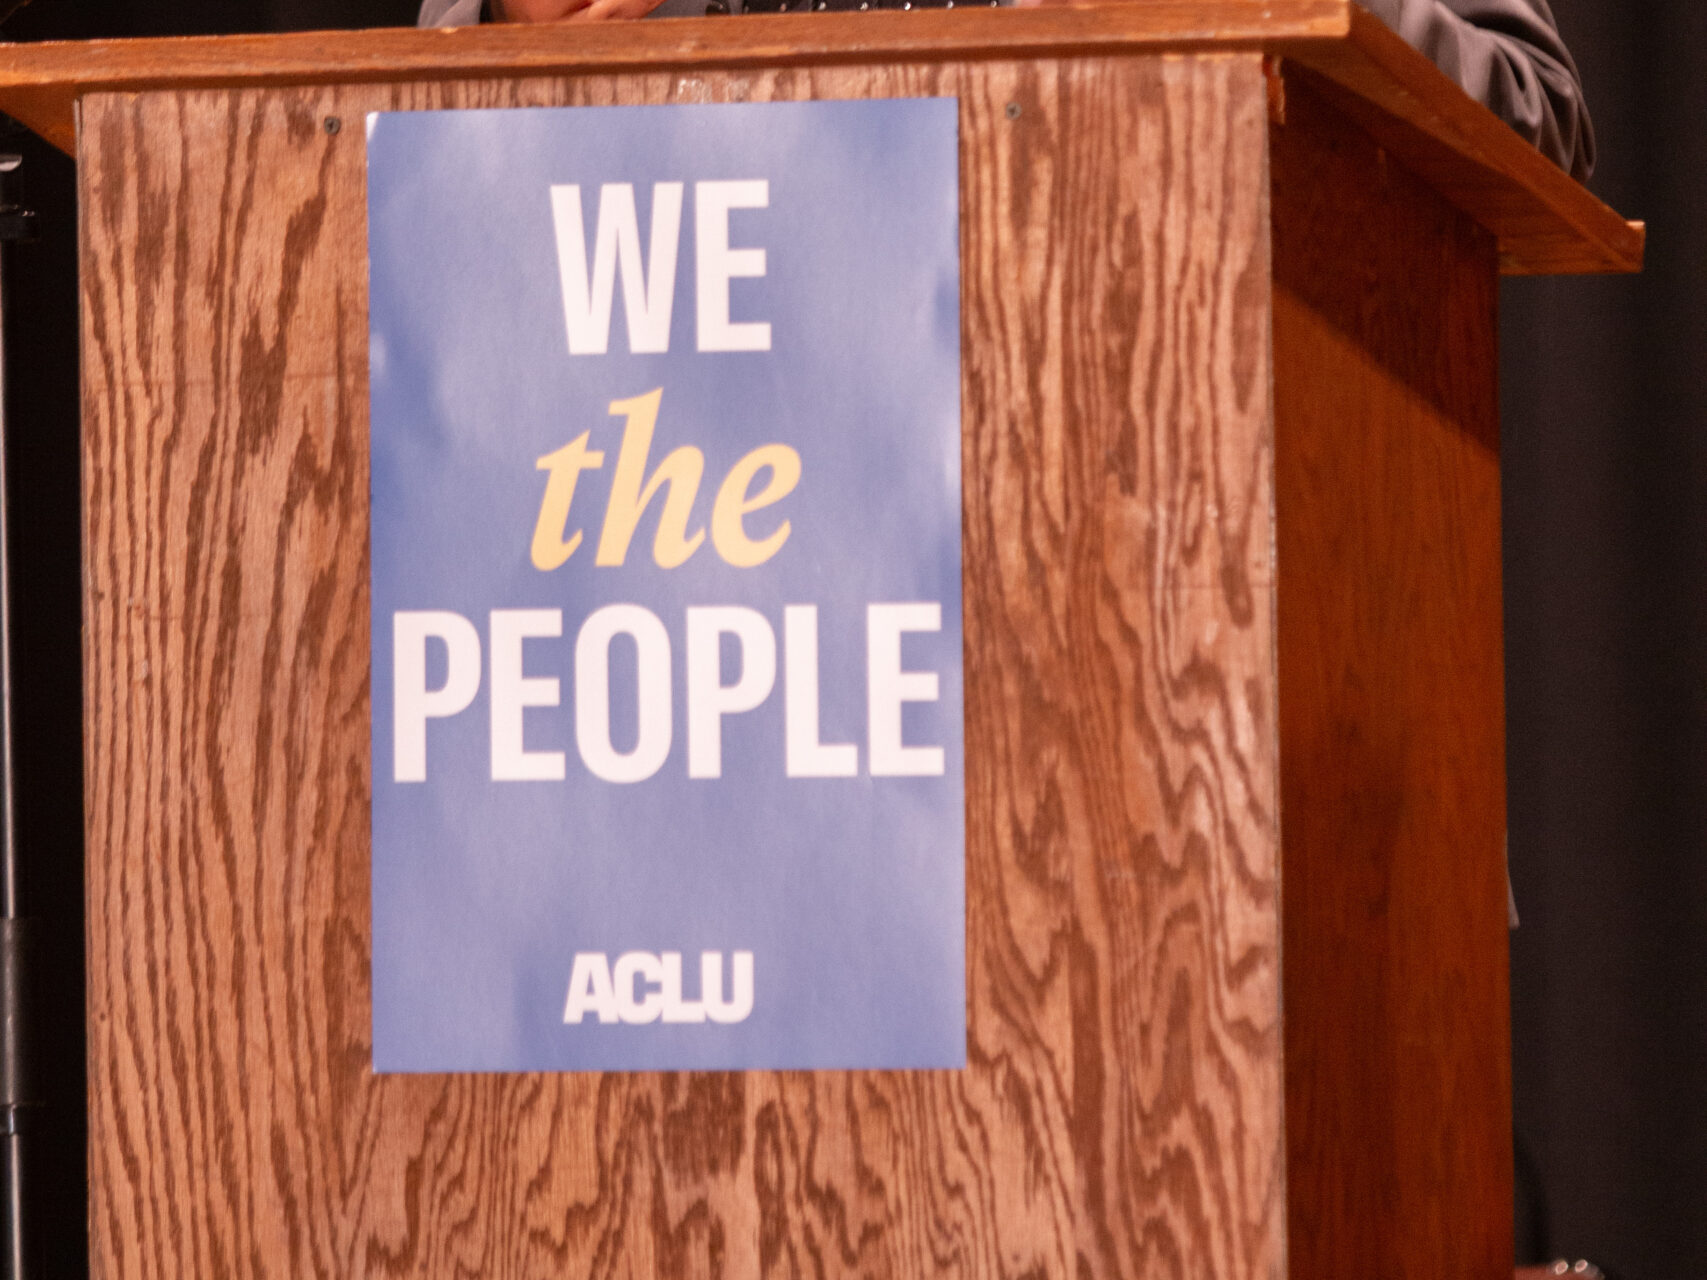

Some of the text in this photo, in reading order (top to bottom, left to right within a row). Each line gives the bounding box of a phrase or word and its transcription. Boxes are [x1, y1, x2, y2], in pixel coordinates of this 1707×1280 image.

[549, 178, 773, 356] WE
[530, 387, 803, 572] the
[392, 601, 947, 784] PEOPLE
[562, 949, 755, 1024] ACLU
